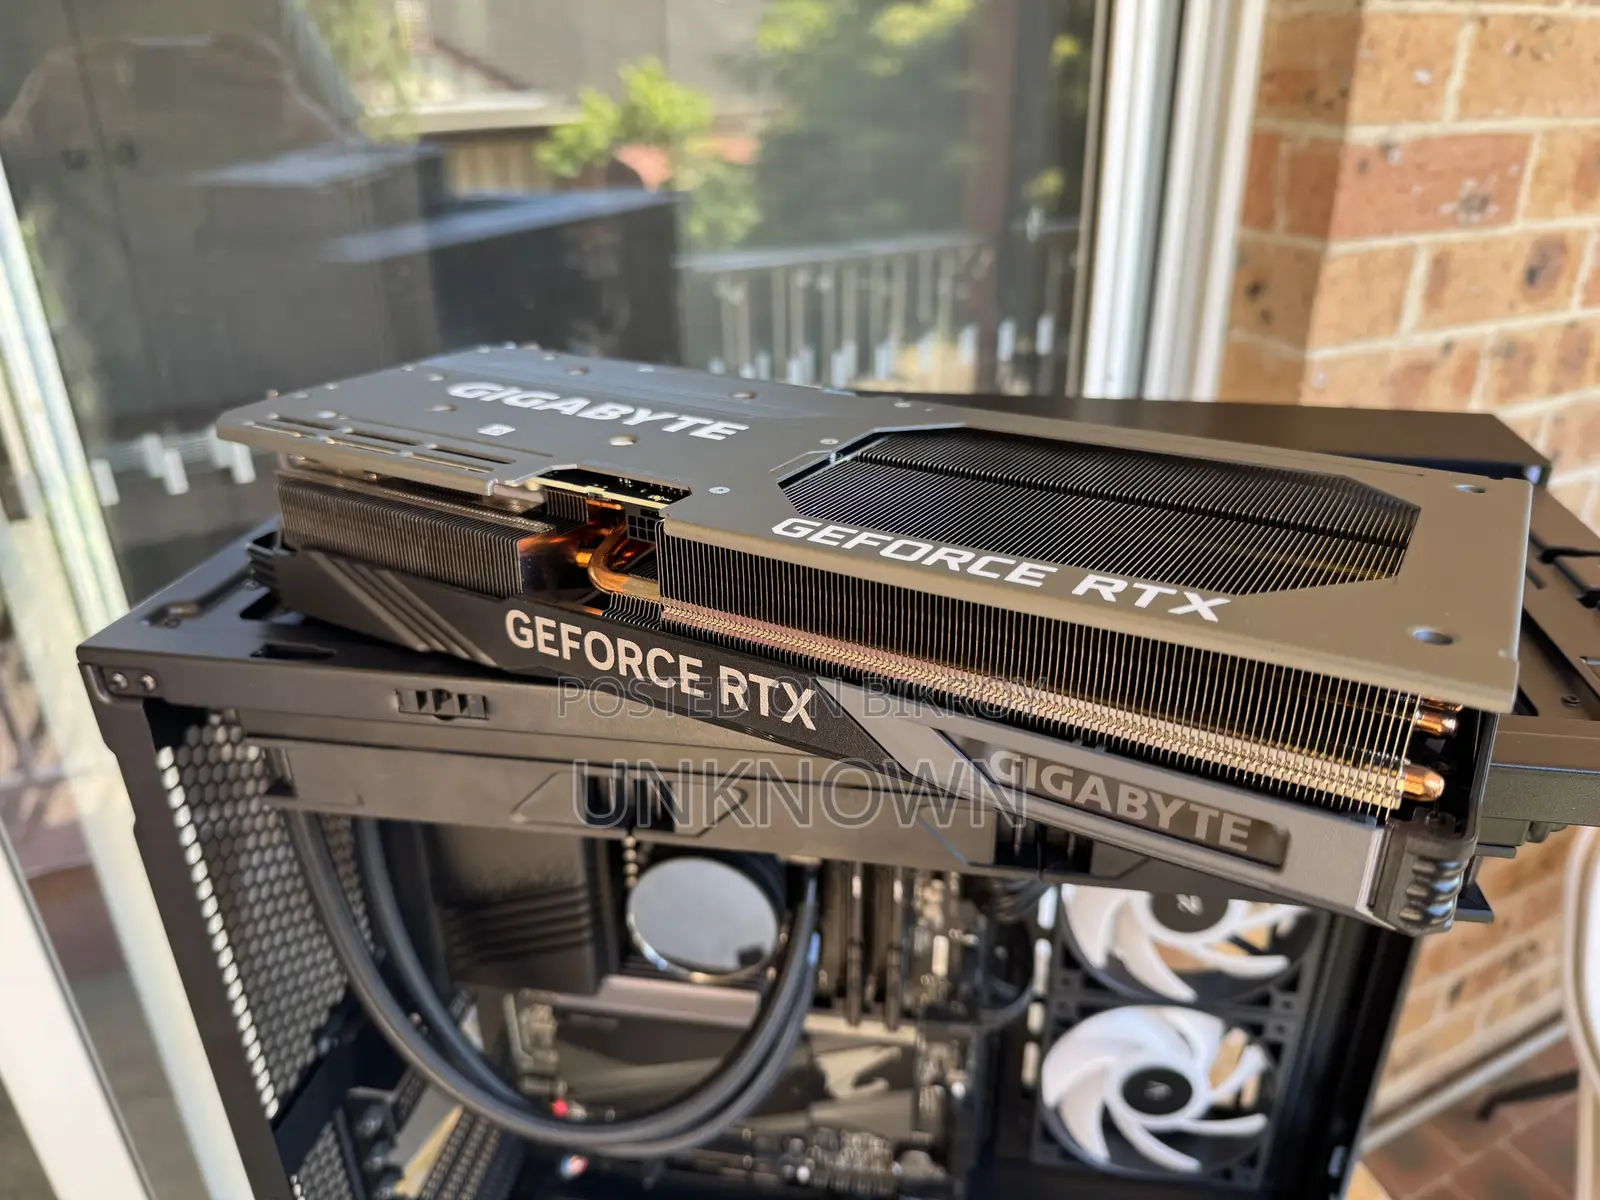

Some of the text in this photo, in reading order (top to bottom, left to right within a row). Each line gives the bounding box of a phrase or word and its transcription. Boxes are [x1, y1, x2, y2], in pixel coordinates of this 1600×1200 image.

[447, 382, 749, 440] GIGABYTE
[772, 518, 1231, 622] GEFORCE RTX
[505, 609, 817, 731] GEFORCE RTX
[990, 749, 1252, 853] GIGABYTE
